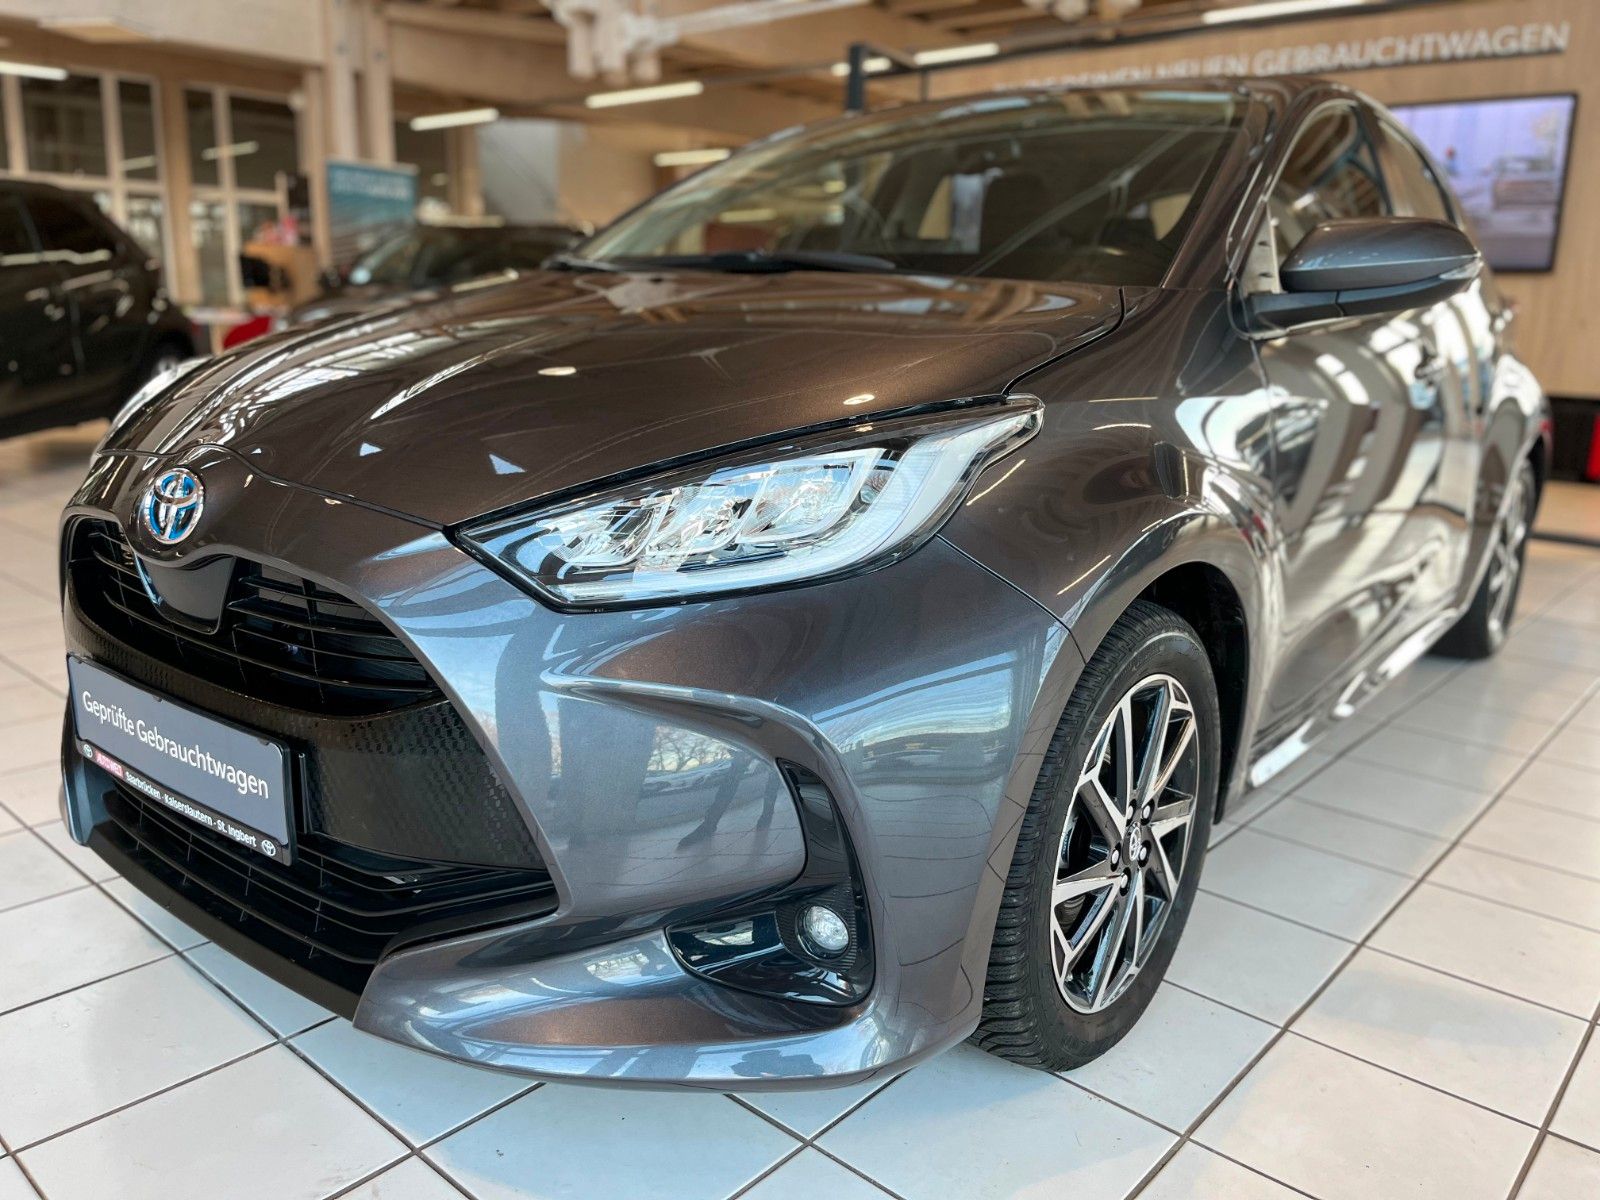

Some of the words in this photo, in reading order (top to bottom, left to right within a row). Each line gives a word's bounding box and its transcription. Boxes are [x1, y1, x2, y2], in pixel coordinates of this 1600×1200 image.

[1253, 20, 1571, 77] GEBRAUCHTWAGEN
[82, 691, 135, 736] Geprüfte
[136, 719, 269, 799] Gebrauchtwagen
